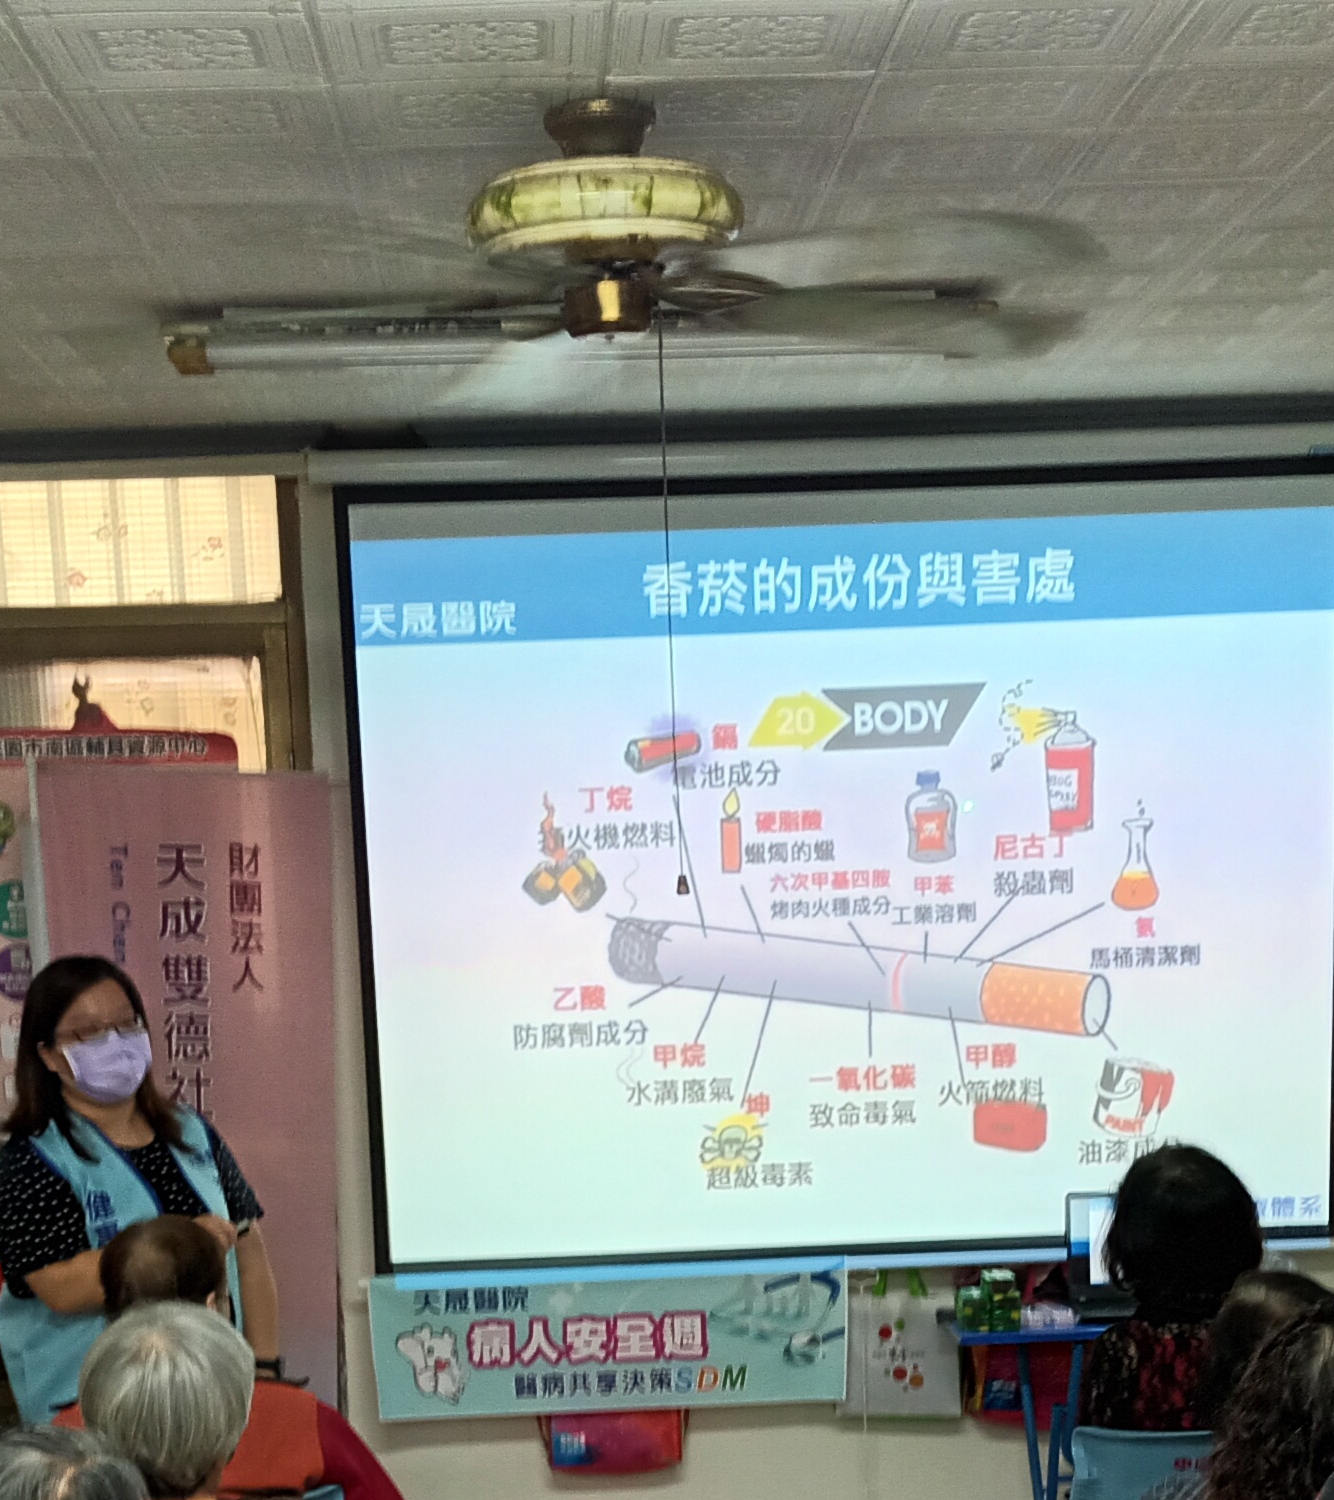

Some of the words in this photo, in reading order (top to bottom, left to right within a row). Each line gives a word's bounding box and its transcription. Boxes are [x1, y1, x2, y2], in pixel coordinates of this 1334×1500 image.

[642, 546, 1077, 619] 香菸的成份與害處
[360, 600, 517, 639] 天晟醫院
[775, 706, 815, 737] 20
[853, 698, 950, 738] BODY
[671, 759, 781, 790] 電池成分
[578, 785, 634, 813] 丁烷
[993, 831, 1074, 861] 尼古丁
[770, 869, 891, 894] 六次甲基四胺
[914, 875, 955, 898] 甲苯
[993, 867, 1074, 897] 殺蟲劑
[229, 840, 265, 994] 財團法人
[770, 895, 892, 921] 烤肉火種成分
[891, 901, 977, 926] 工業溶劑
[1089, 943, 1201, 969] 馬桶清潔劑
[552, 985, 606, 1012] 乙酸
[513, 1019, 649, 1051] 防腐劑成分
[653, 1043, 706, 1070] 甲烷
[626, 1077, 735, 1107] 水溝廢氣
[809, 1063, 916, 1092] 一氧化碳
[809, 1099, 916, 1129] 致命毒氣
[1078, 1137, 1179, 1167] 油漆成
[706, 1161, 814, 1191] 超級毒素
[467, 1310, 709, 1370] 病人安全週
